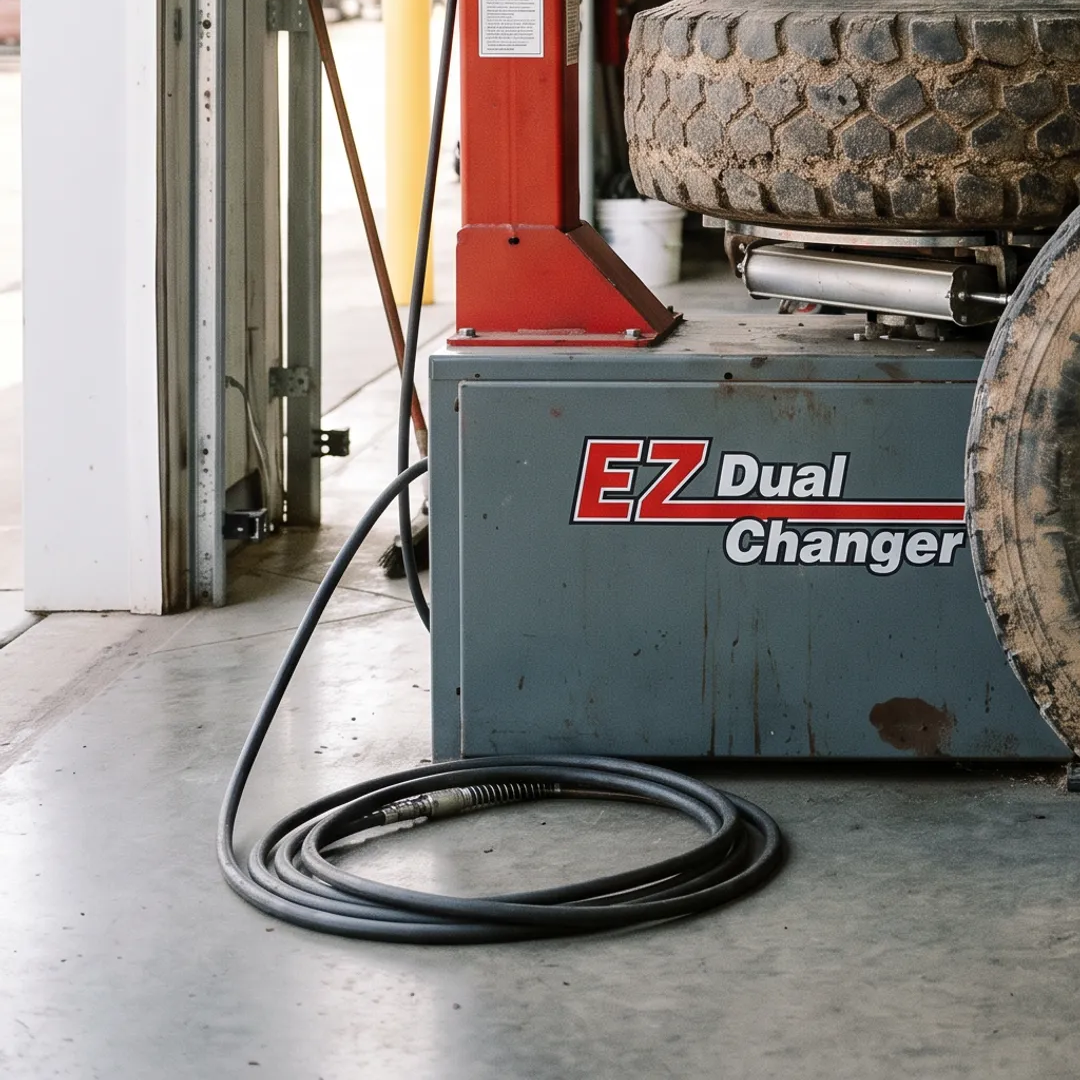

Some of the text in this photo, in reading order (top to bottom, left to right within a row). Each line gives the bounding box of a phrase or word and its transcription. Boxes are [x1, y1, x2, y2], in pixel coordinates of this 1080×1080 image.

[570, 436, 850, 524] EZ Dual
[724, 517, 965, 575] Changer
